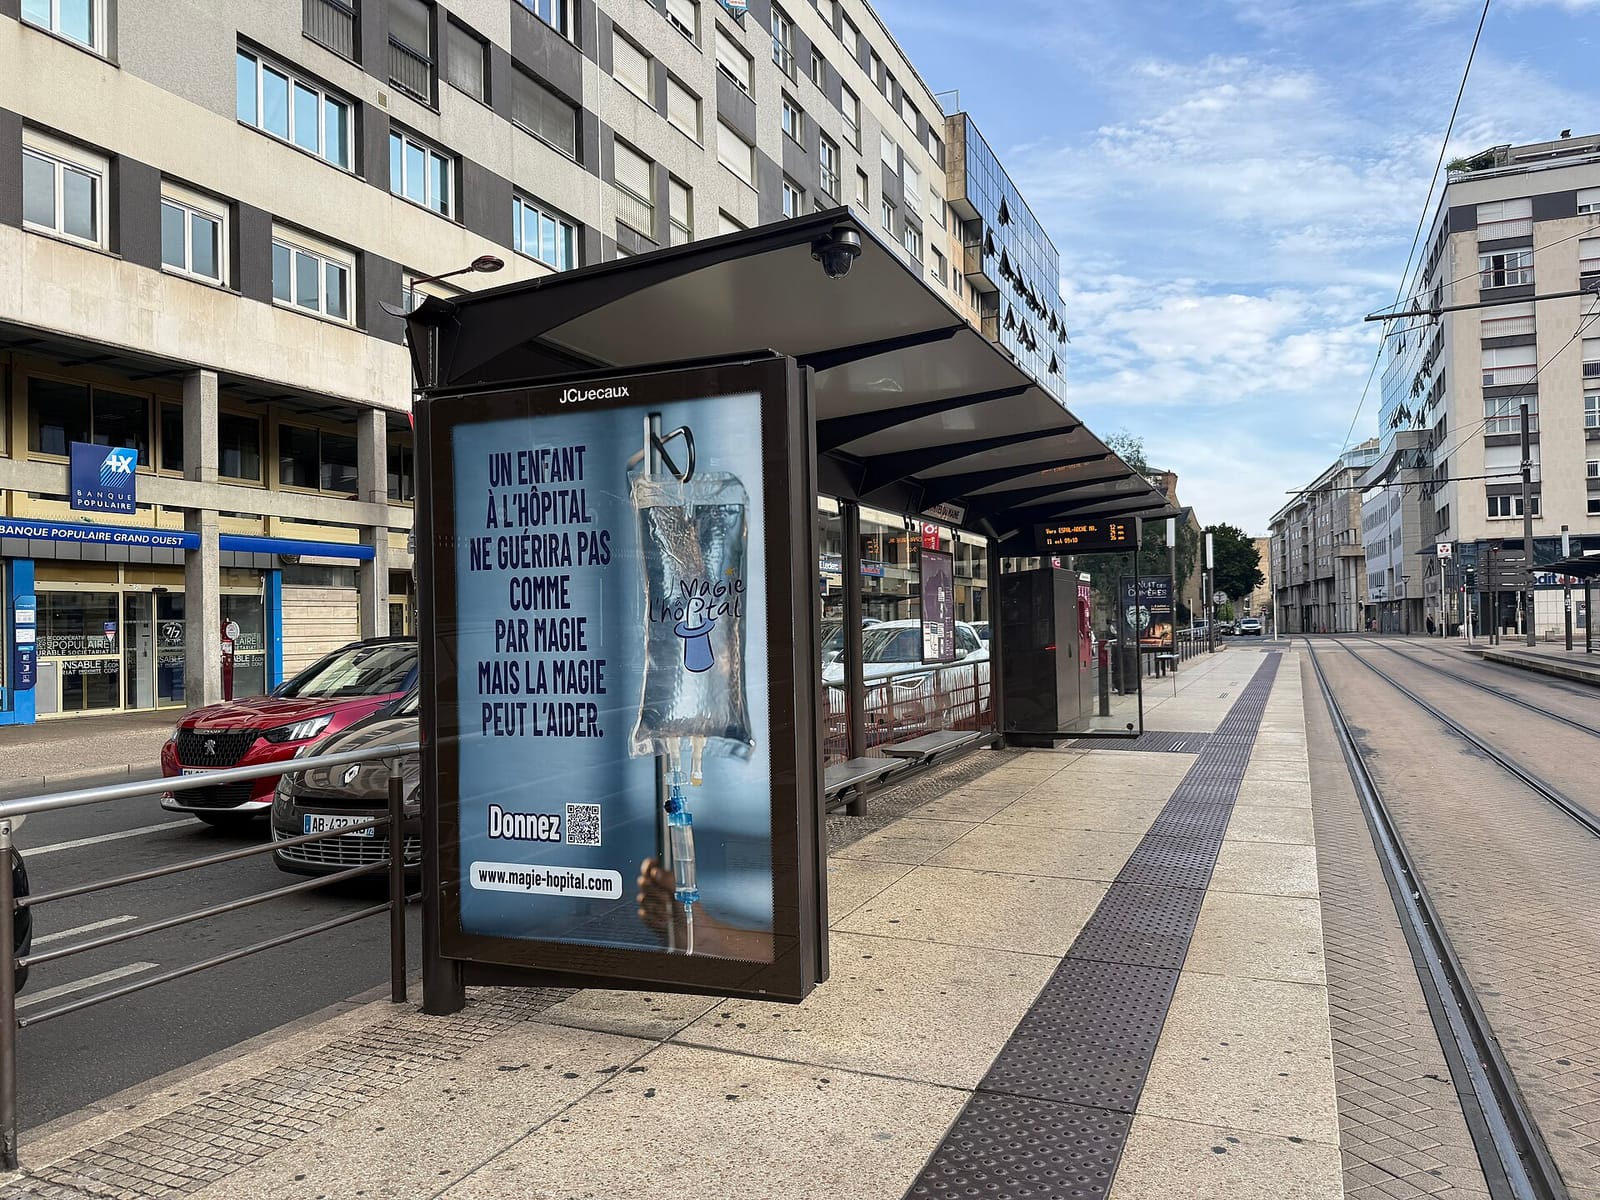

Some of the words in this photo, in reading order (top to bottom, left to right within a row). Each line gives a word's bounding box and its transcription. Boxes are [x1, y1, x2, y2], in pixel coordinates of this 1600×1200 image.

[488, 451, 513, 487] UN
[517, 444, 586, 484] ENFANT
[77, 489, 132, 501] BANQUE
[77, 499, 132, 510] POPULAIRE
[486, 489, 498, 529] À
[503, 486, 592, 529] L'HÔPITAL
[0, 525, 48, 537] BANQUE
[51, 528, 112, 542] POPULAIRE
[113, 533, 150, 544] GRAND
[151, 536, 184, 546] OUEST
[470, 536, 493, 571] NE
[497, 526, 572, 570] GUÉRIRA
[577, 530, 611, 567] PAS
[509, 574, 571, 612] COMME
[36, 649, 66, 657] URABLE
[52, 640, 109, 650] POPULAIRE
[495, 619, 529, 654] PAR
[534, 617, 587, 653] MAGIE
[478, 660, 520, 696] MAIS
[525, 660, 549, 695] LA
[553, 658, 607, 695] MAGIE
[482, 702, 527, 737] PEUT
[532, 702, 604, 738] L'AIDER.
[488, 803, 562, 843] Donnez
[478, 868, 613, 893] www.magie-hopital.com
